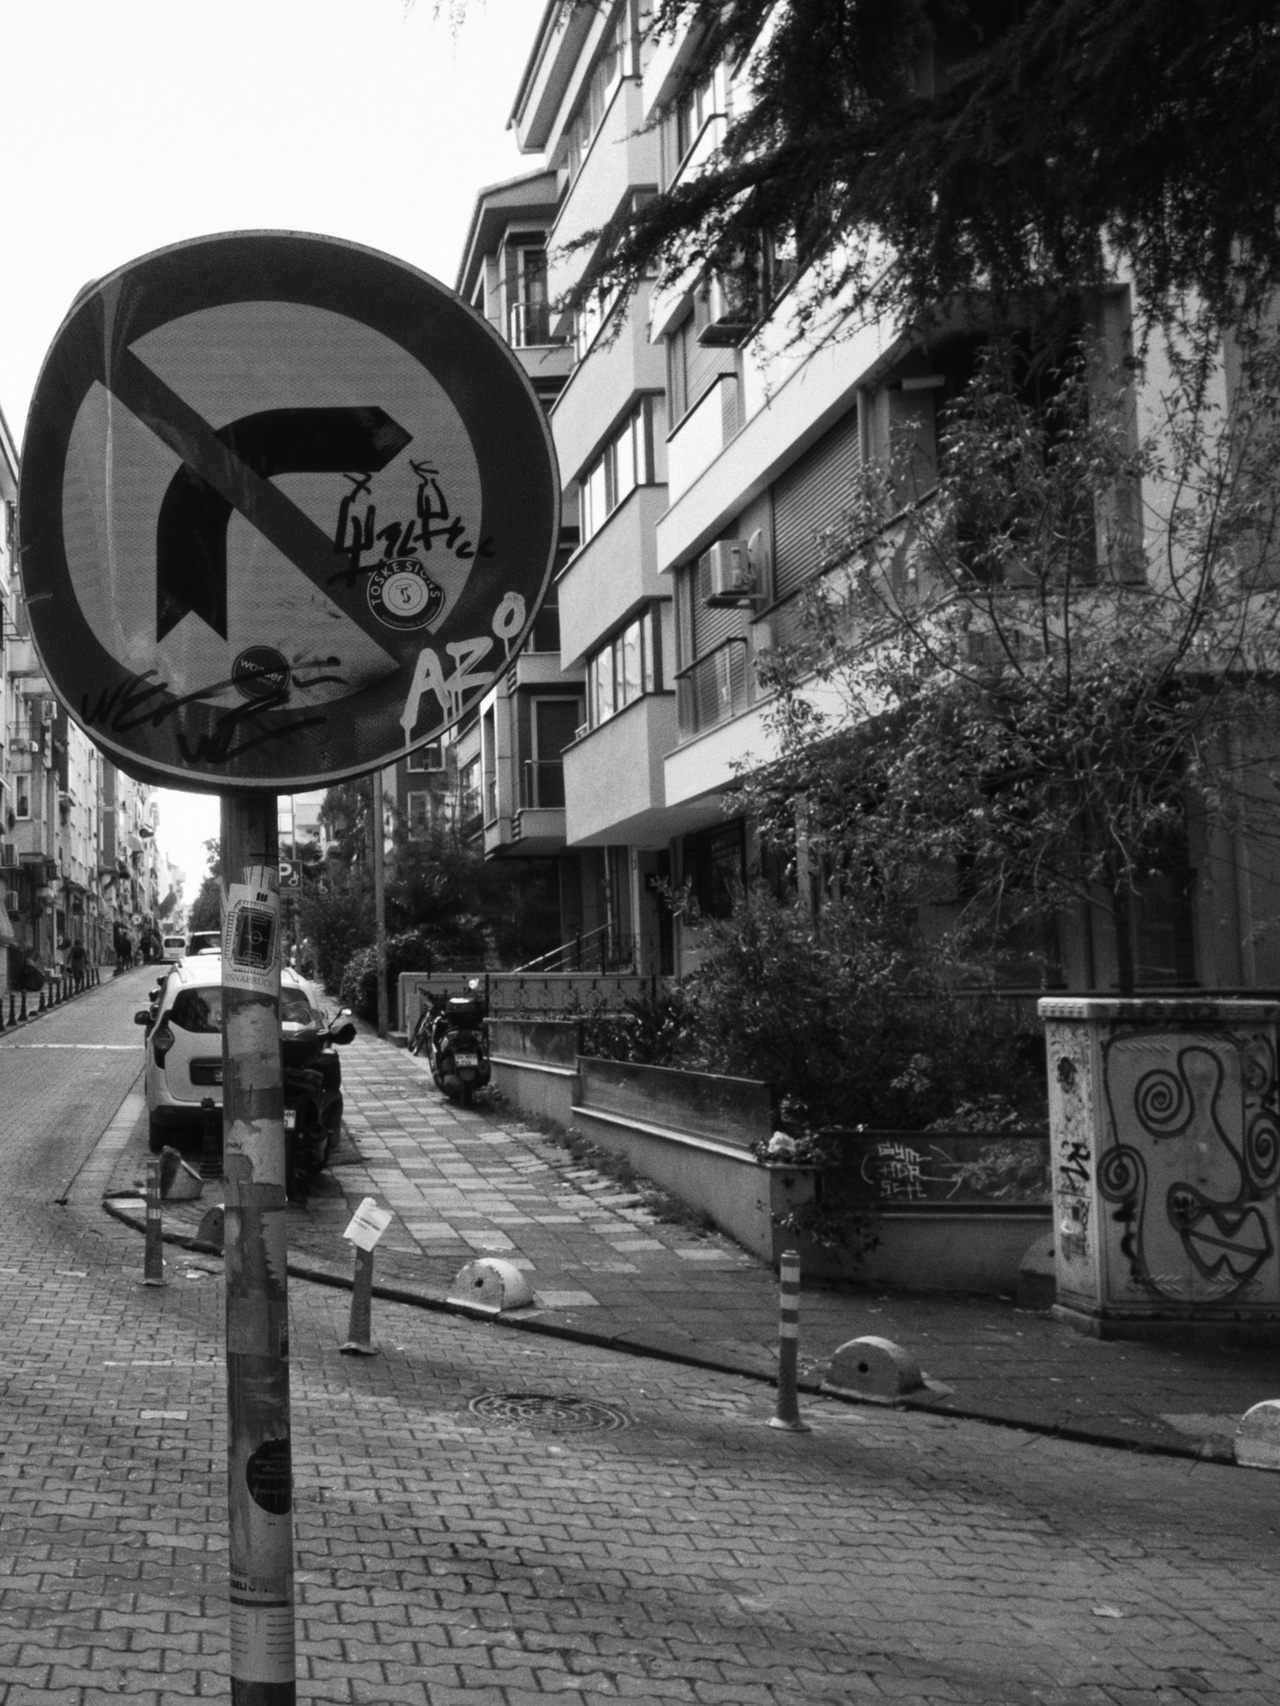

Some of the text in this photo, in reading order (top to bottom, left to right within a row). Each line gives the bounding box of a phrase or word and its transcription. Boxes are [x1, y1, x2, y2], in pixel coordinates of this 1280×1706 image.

[370, 562, 401, 606] TOSKE
[240, 658, 284, 683] waer
[278, 863, 292, 883] P
